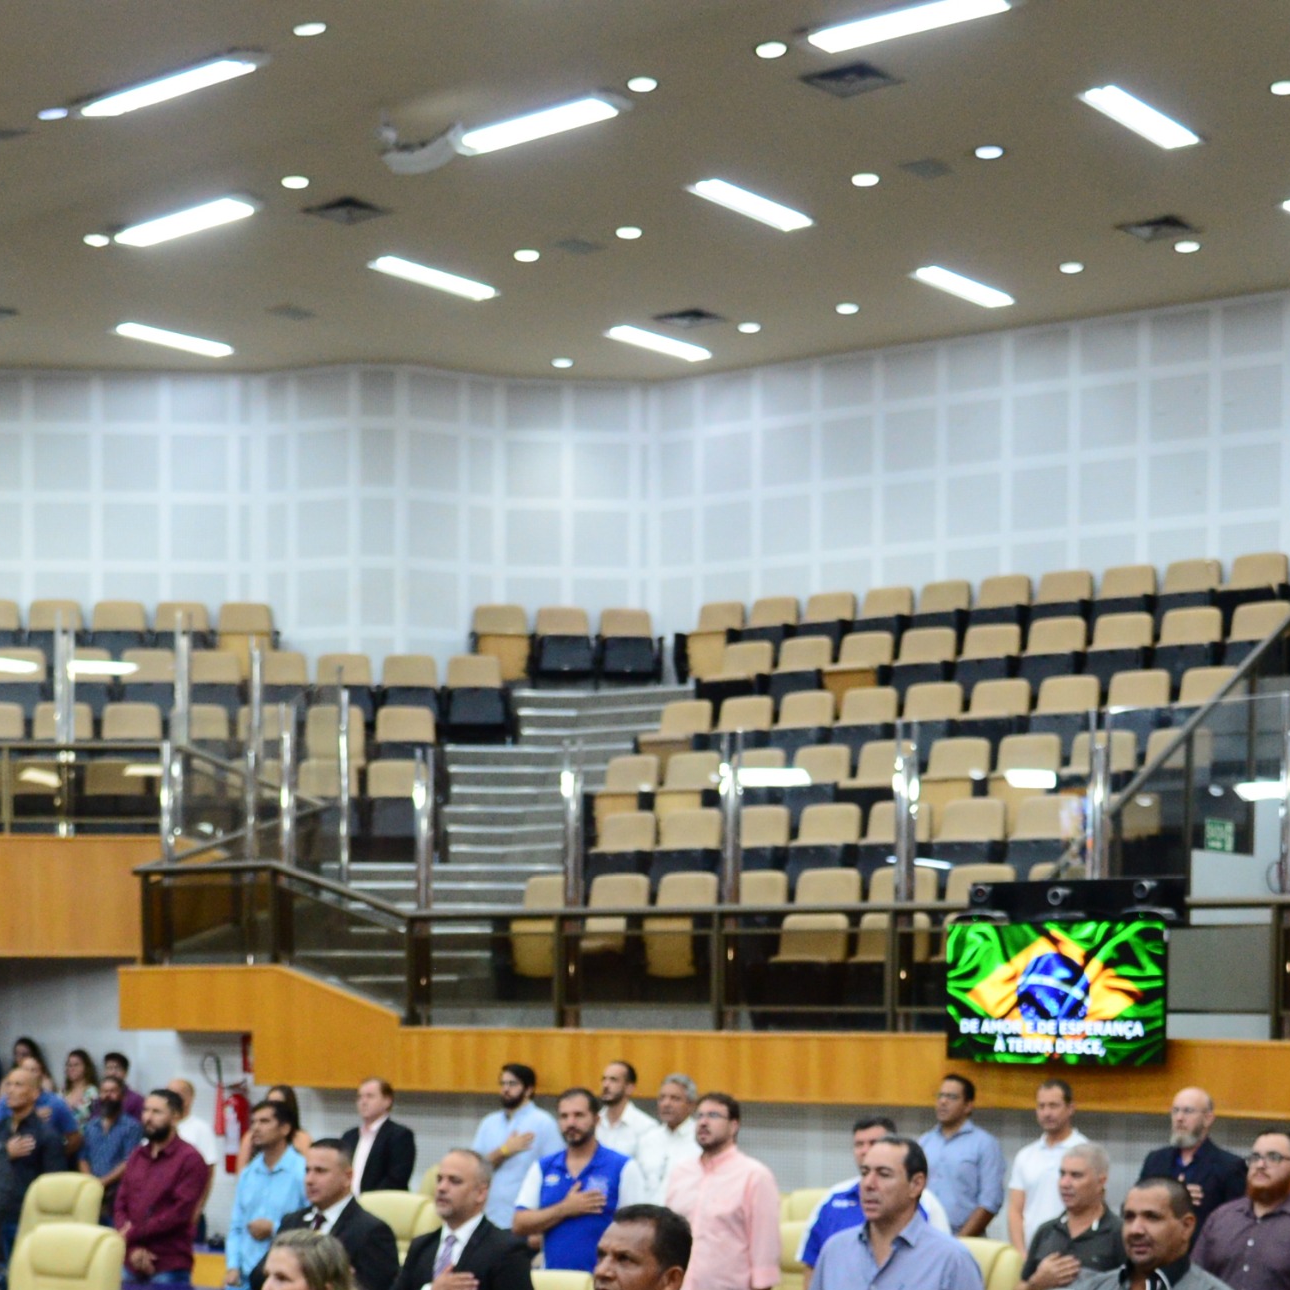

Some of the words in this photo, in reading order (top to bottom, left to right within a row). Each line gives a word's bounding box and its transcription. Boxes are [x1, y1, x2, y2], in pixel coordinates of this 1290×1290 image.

[959, 1018, 980, 1034] DE
[981, 1019, 1021, 1035] AMOR
[1026, 1019, 1036, 1035] E
[1037, 1020, 1056, 1035] DE
[1059, 1020, 1144, 1039] ESPERANÇA
[1007, 1037, 1054, 1054] TERRA
